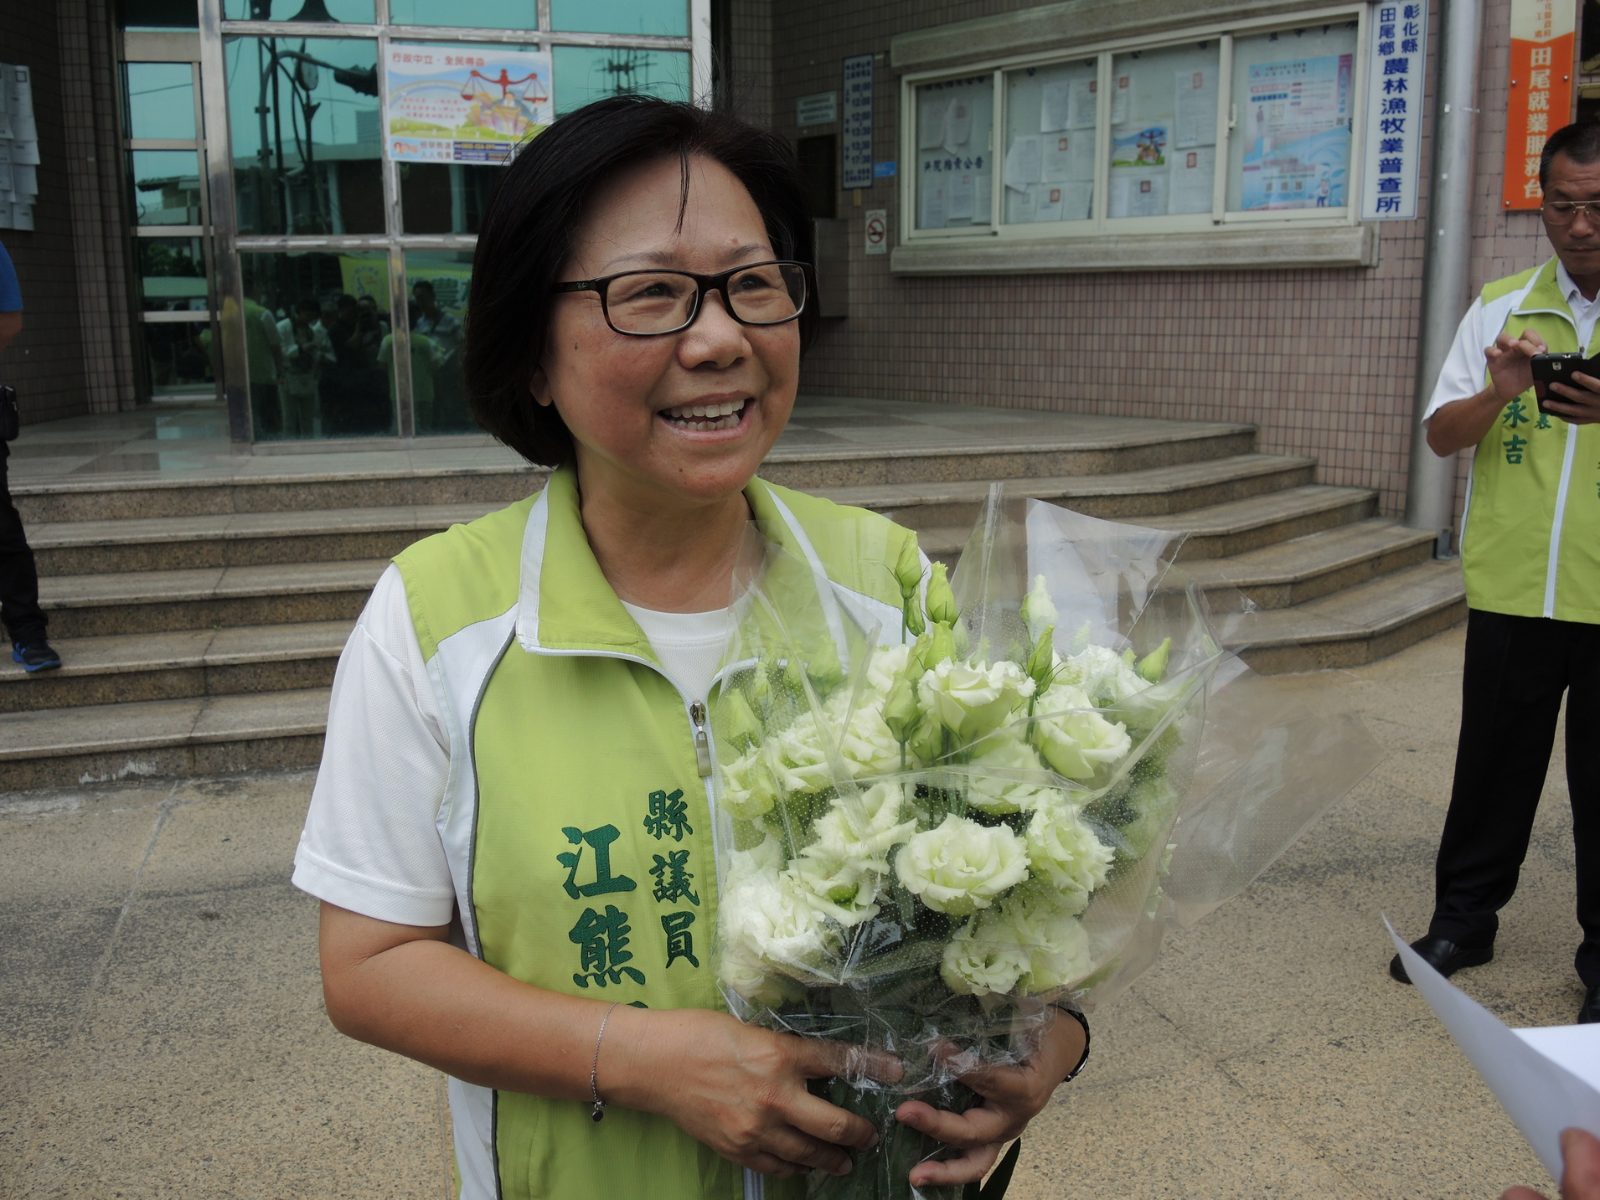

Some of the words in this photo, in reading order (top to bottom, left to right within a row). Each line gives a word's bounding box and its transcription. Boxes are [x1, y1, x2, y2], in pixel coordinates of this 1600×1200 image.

[1378, 7, 1396, 55] 田尾鄉
[1401, 5, 1420, 53] 彰化縣
[1376, 57, 1409, 213] 農林漁牧業普查所
[1503, 396, 1530, 464] 永吉
[556, 824, 648, 1008] 江熊
[643, 788, 700, 968] 縣議員
